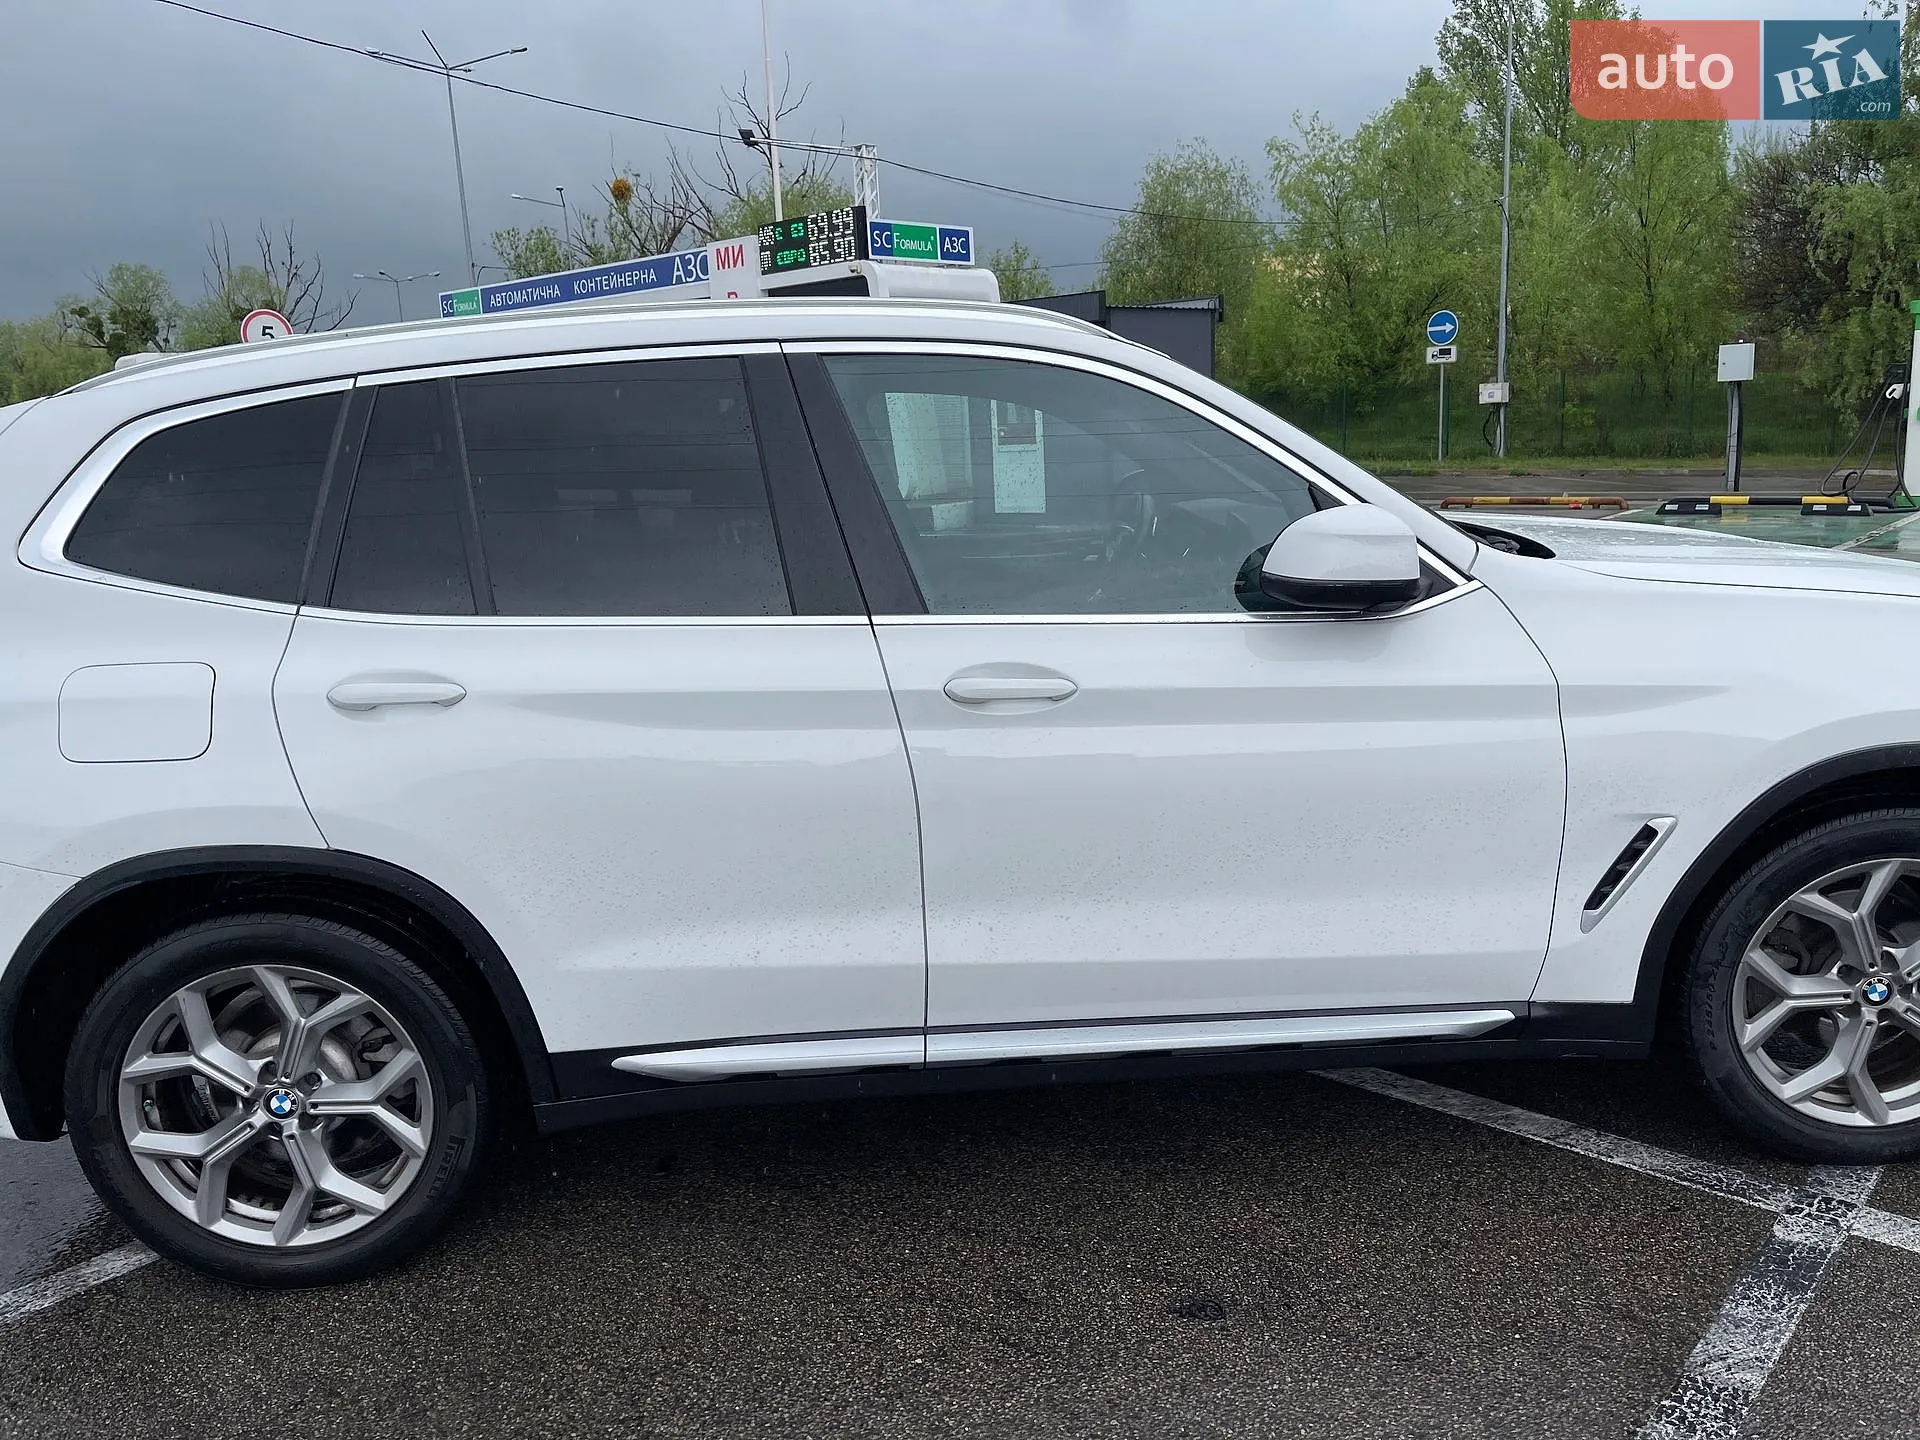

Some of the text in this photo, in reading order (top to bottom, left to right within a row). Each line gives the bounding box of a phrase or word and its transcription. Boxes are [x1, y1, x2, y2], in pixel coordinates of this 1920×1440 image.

[873, 230, 892, 248] SC
[943, 236, 967, 254] АЗС
[489, 251, 710, 308] АВТОМАТИЧНА КОНТЕЙНЕРНА АЗС
[442, 299, 454, 314] SC
[261, 325, 275, 339] 5
